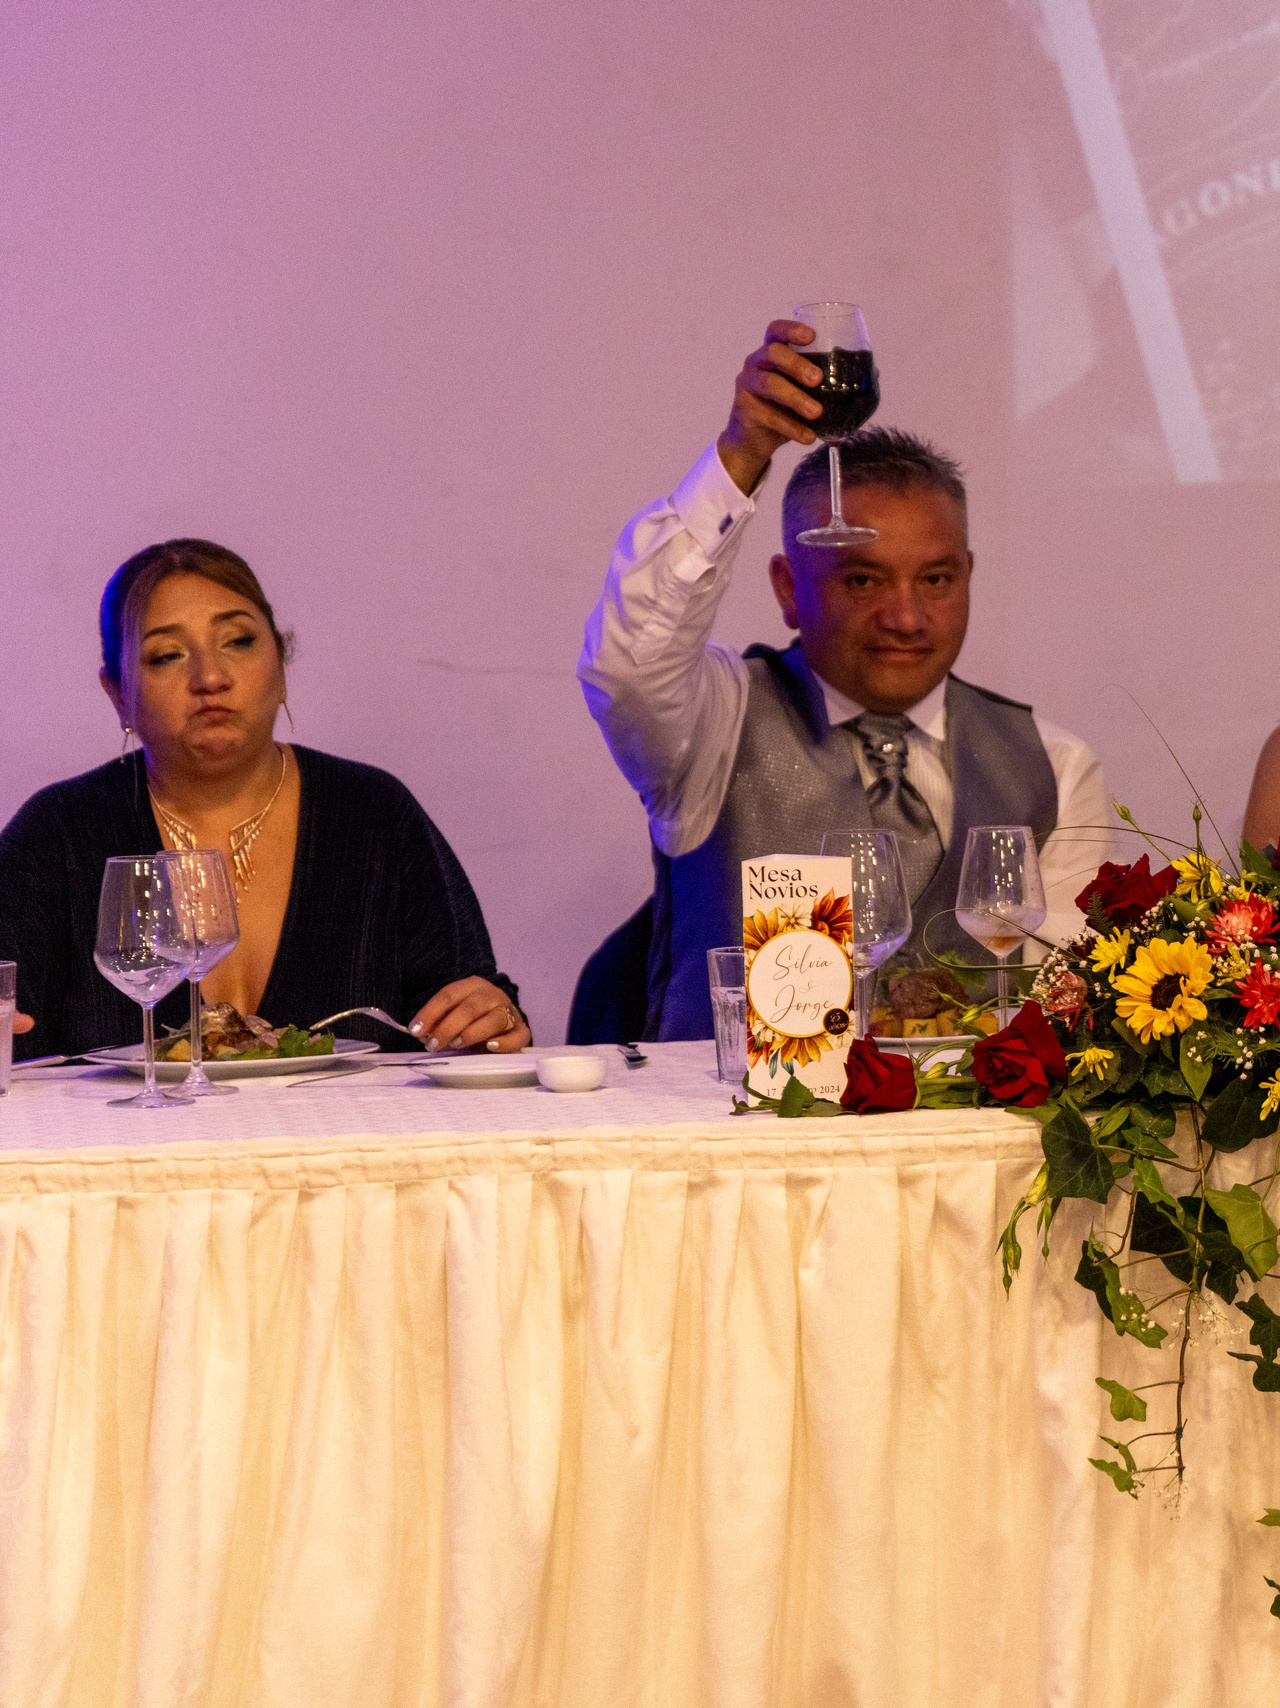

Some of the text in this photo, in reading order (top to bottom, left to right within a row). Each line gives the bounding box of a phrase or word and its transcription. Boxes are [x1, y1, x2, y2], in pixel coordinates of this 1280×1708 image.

[748, 866, 802, 883] Mesa
[749, 882, 819, 900] Novios
[772, 944, 833, 981] Silvia
[770, 984, 834, 1024] Jorge
[766, 1088, 777, 1097] 17
[819, 1085, 840, 1094] 2024
